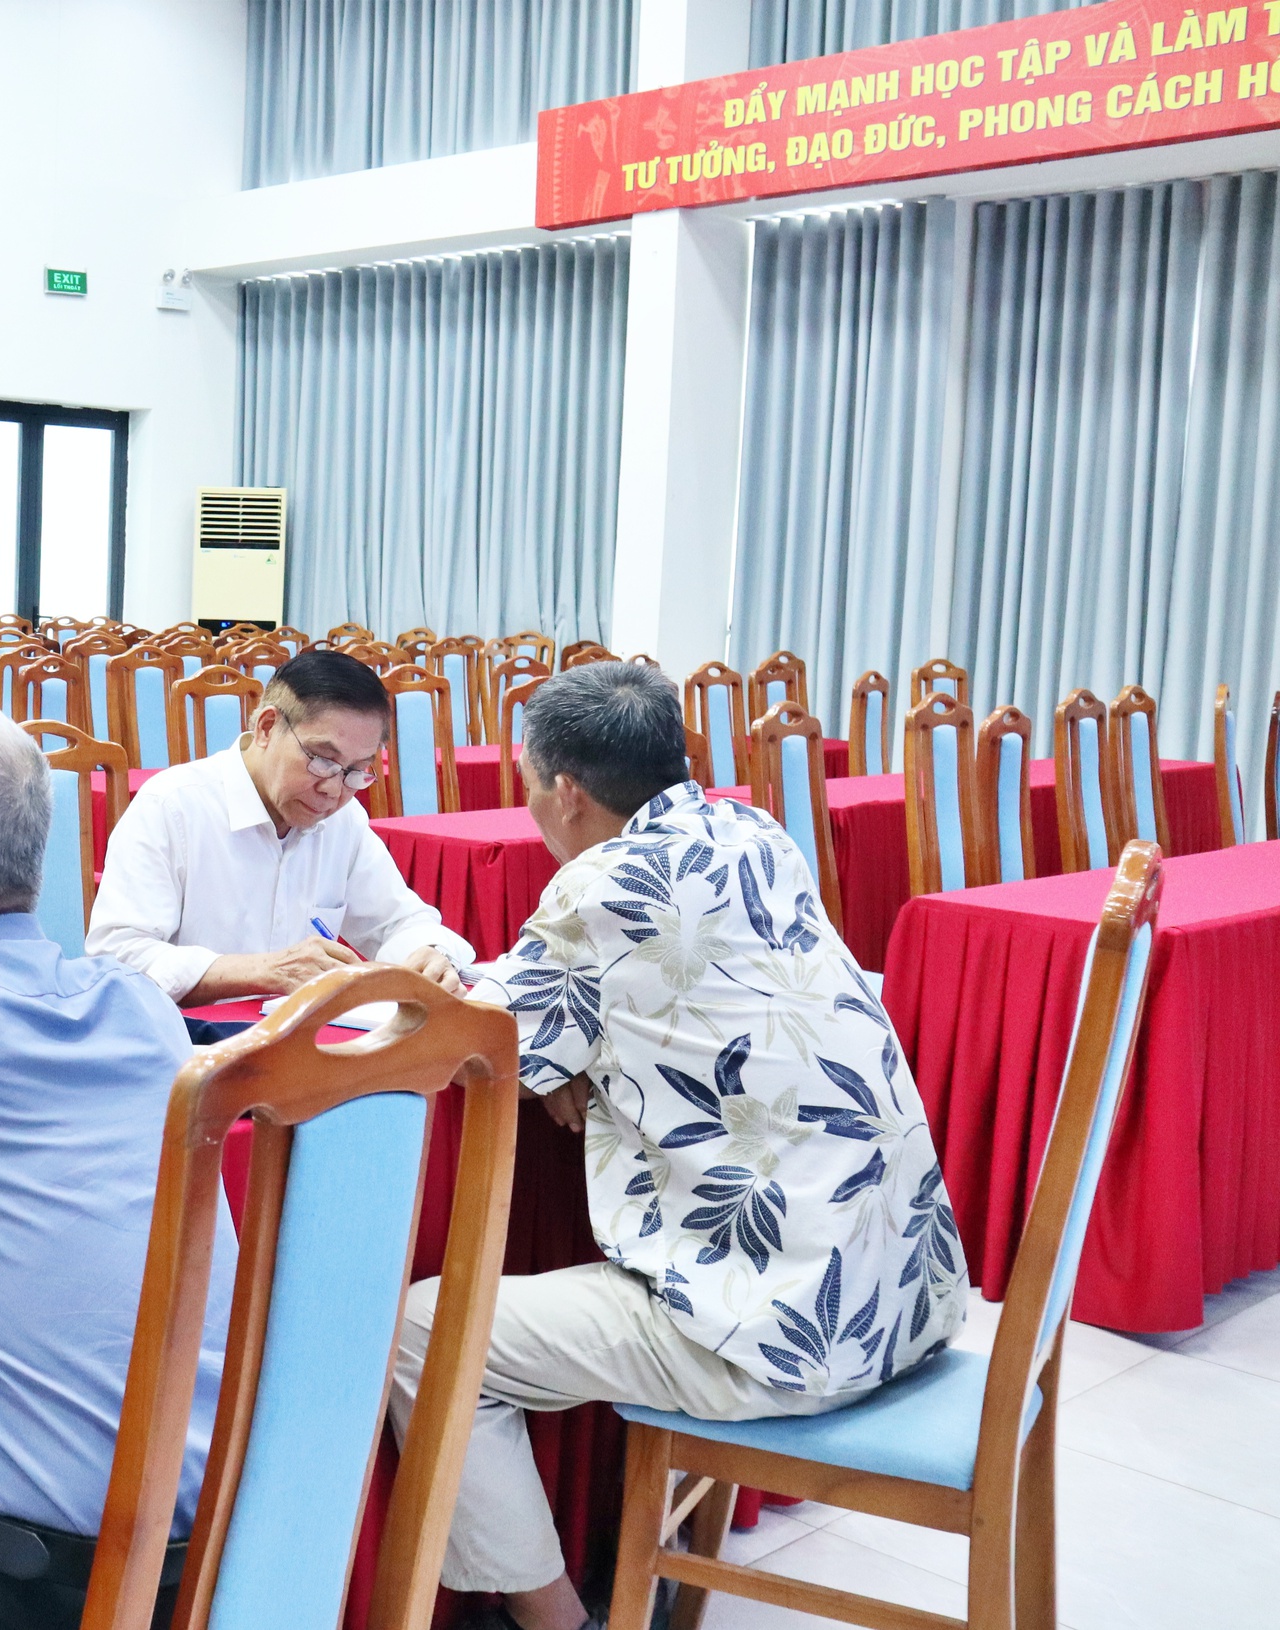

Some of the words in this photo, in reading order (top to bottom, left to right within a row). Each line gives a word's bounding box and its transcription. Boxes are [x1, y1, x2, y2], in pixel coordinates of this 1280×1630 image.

[724, 81, 787, 128] ĐẨY
[796, 69, 900, 117] MẠNH
[910, 55, 985, 99] HỌC
[997, 38, 1071, 86] TẬP
[1084, 21, 1137, 67] VÀ
[1151, 6, 1248, 56] LÀM
[622, 156, 660, 191] TƯ
[665, 140, 776, 186] TƯỞNG,
[786, 128, 853, 169] ĐẠO
[864, 112, 947, 155] ĐỨC,
[958, 90, 1093, 142] PHONG
[1106, 69, 1224, 119] CÁCH
[53, 272, 81, 285] EXIT
